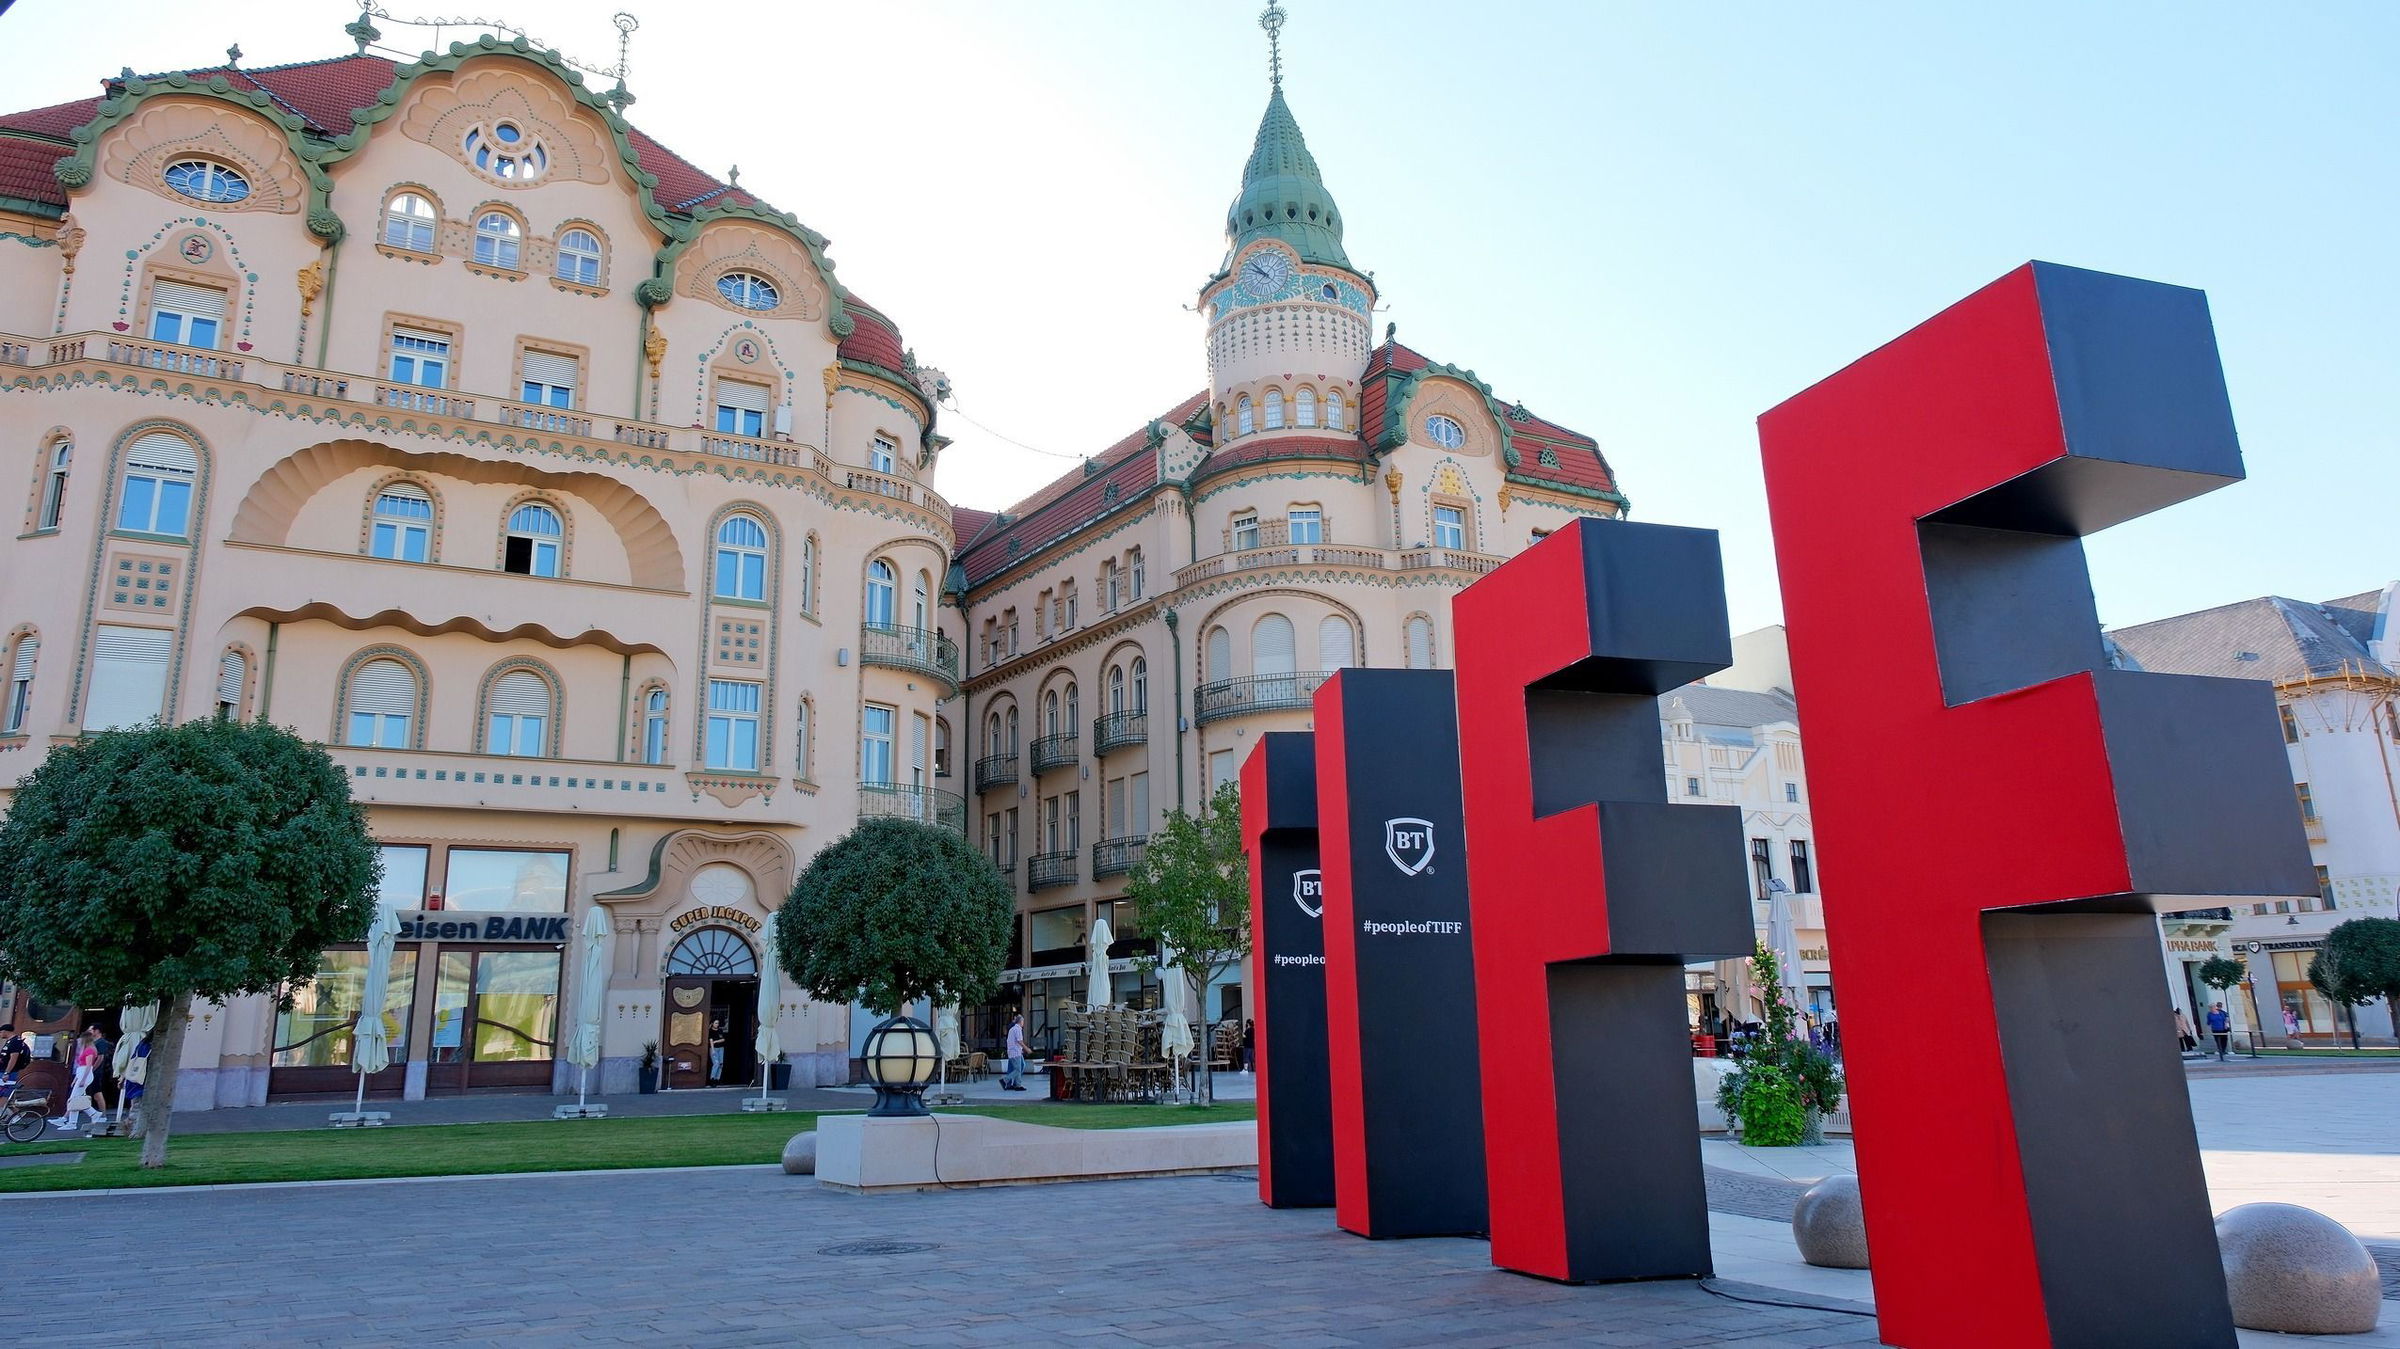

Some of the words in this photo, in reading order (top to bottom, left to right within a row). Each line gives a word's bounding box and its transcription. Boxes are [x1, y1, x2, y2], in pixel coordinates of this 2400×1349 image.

[1395, 831, 1424, 849] BT
[670, 906, 710, 932] SUPER
[712, 905, 762, 933] JACKPOT
[483, 916, 569, 940] BANK
[1363, 920, 1462, 936] #peopleofTIFF
[1799, 949, 1817, 960] BCR
[2189, 940, 2218, 952] BANK
